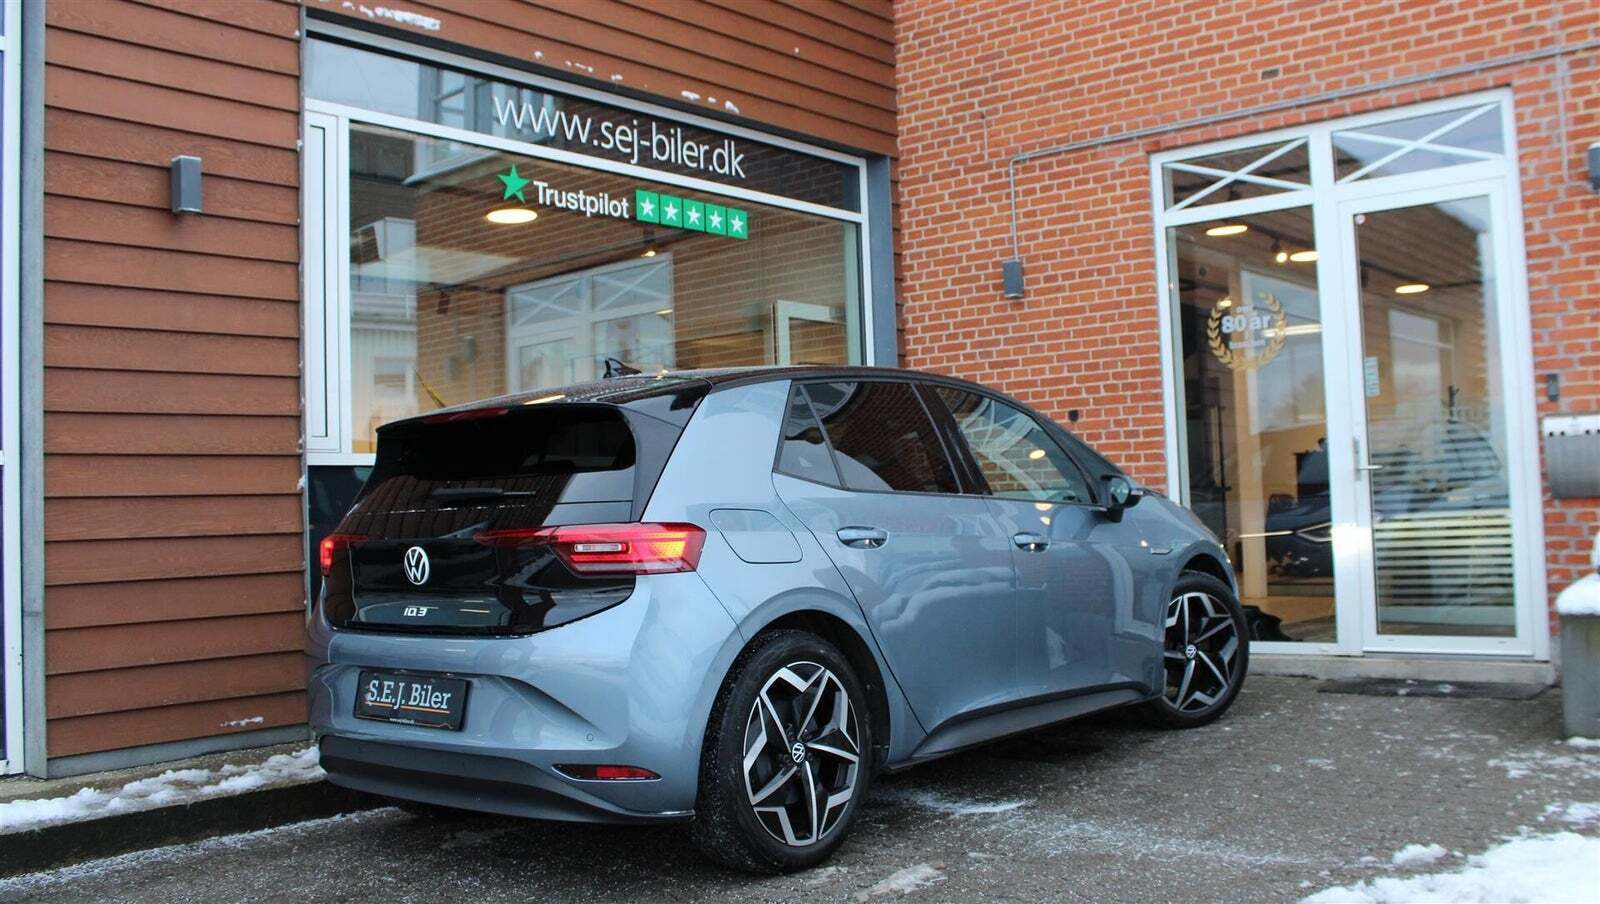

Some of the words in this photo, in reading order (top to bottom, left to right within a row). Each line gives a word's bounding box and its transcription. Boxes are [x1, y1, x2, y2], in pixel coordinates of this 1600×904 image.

[494, 97, 746, 178] www.sej-biler.dk
[533, 181, 629, 219] Trustpilot
[1221, 315, 1246, 333] 80
[367, 679, 406, 709] S.E.J.
[409, 683, 452, 709] Biler
